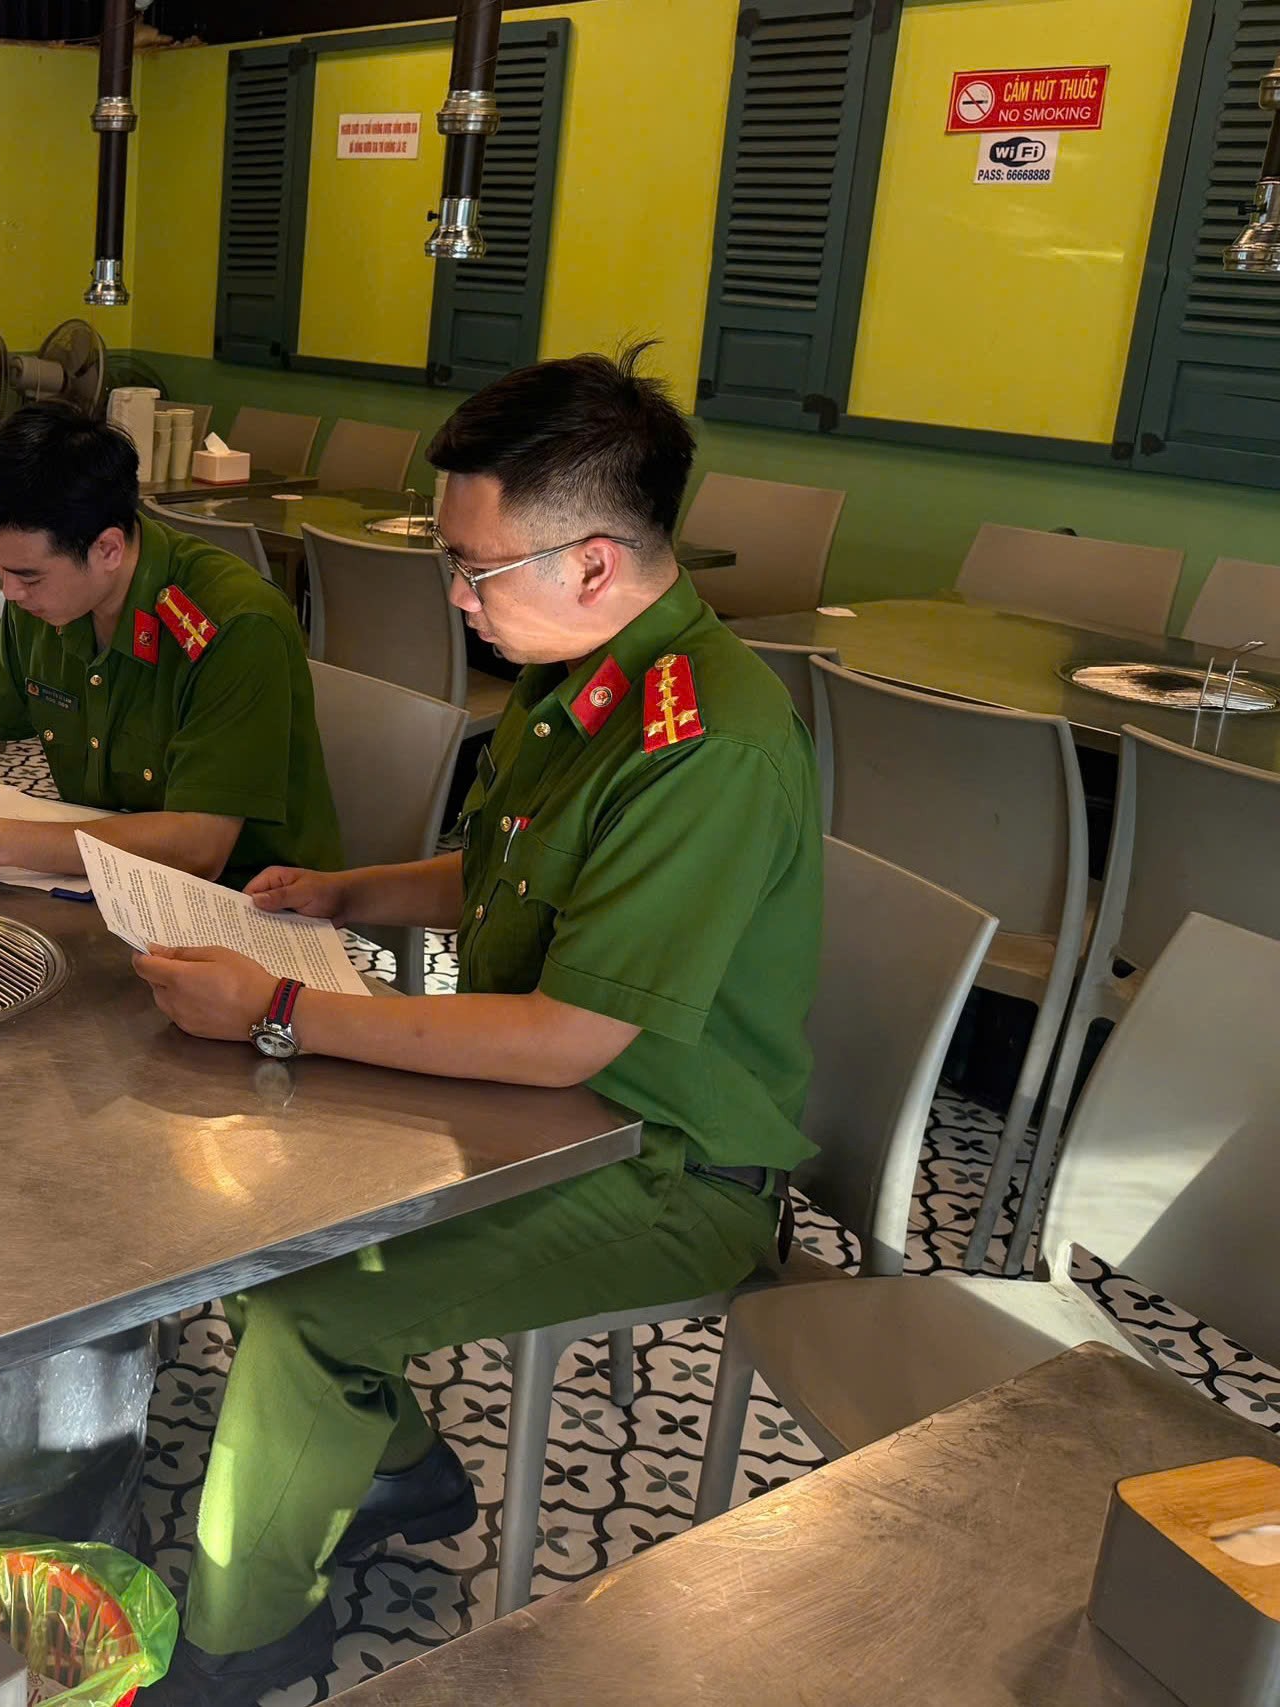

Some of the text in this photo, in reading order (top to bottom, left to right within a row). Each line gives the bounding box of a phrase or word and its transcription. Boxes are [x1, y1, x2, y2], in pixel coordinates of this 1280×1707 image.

[1004, 71, 1098, 103] CẤM HÚT THUỐC
[998, 107, 1091, 122] NO SMOKING
[977, 169, 1050, 181] PASS: 66668888
